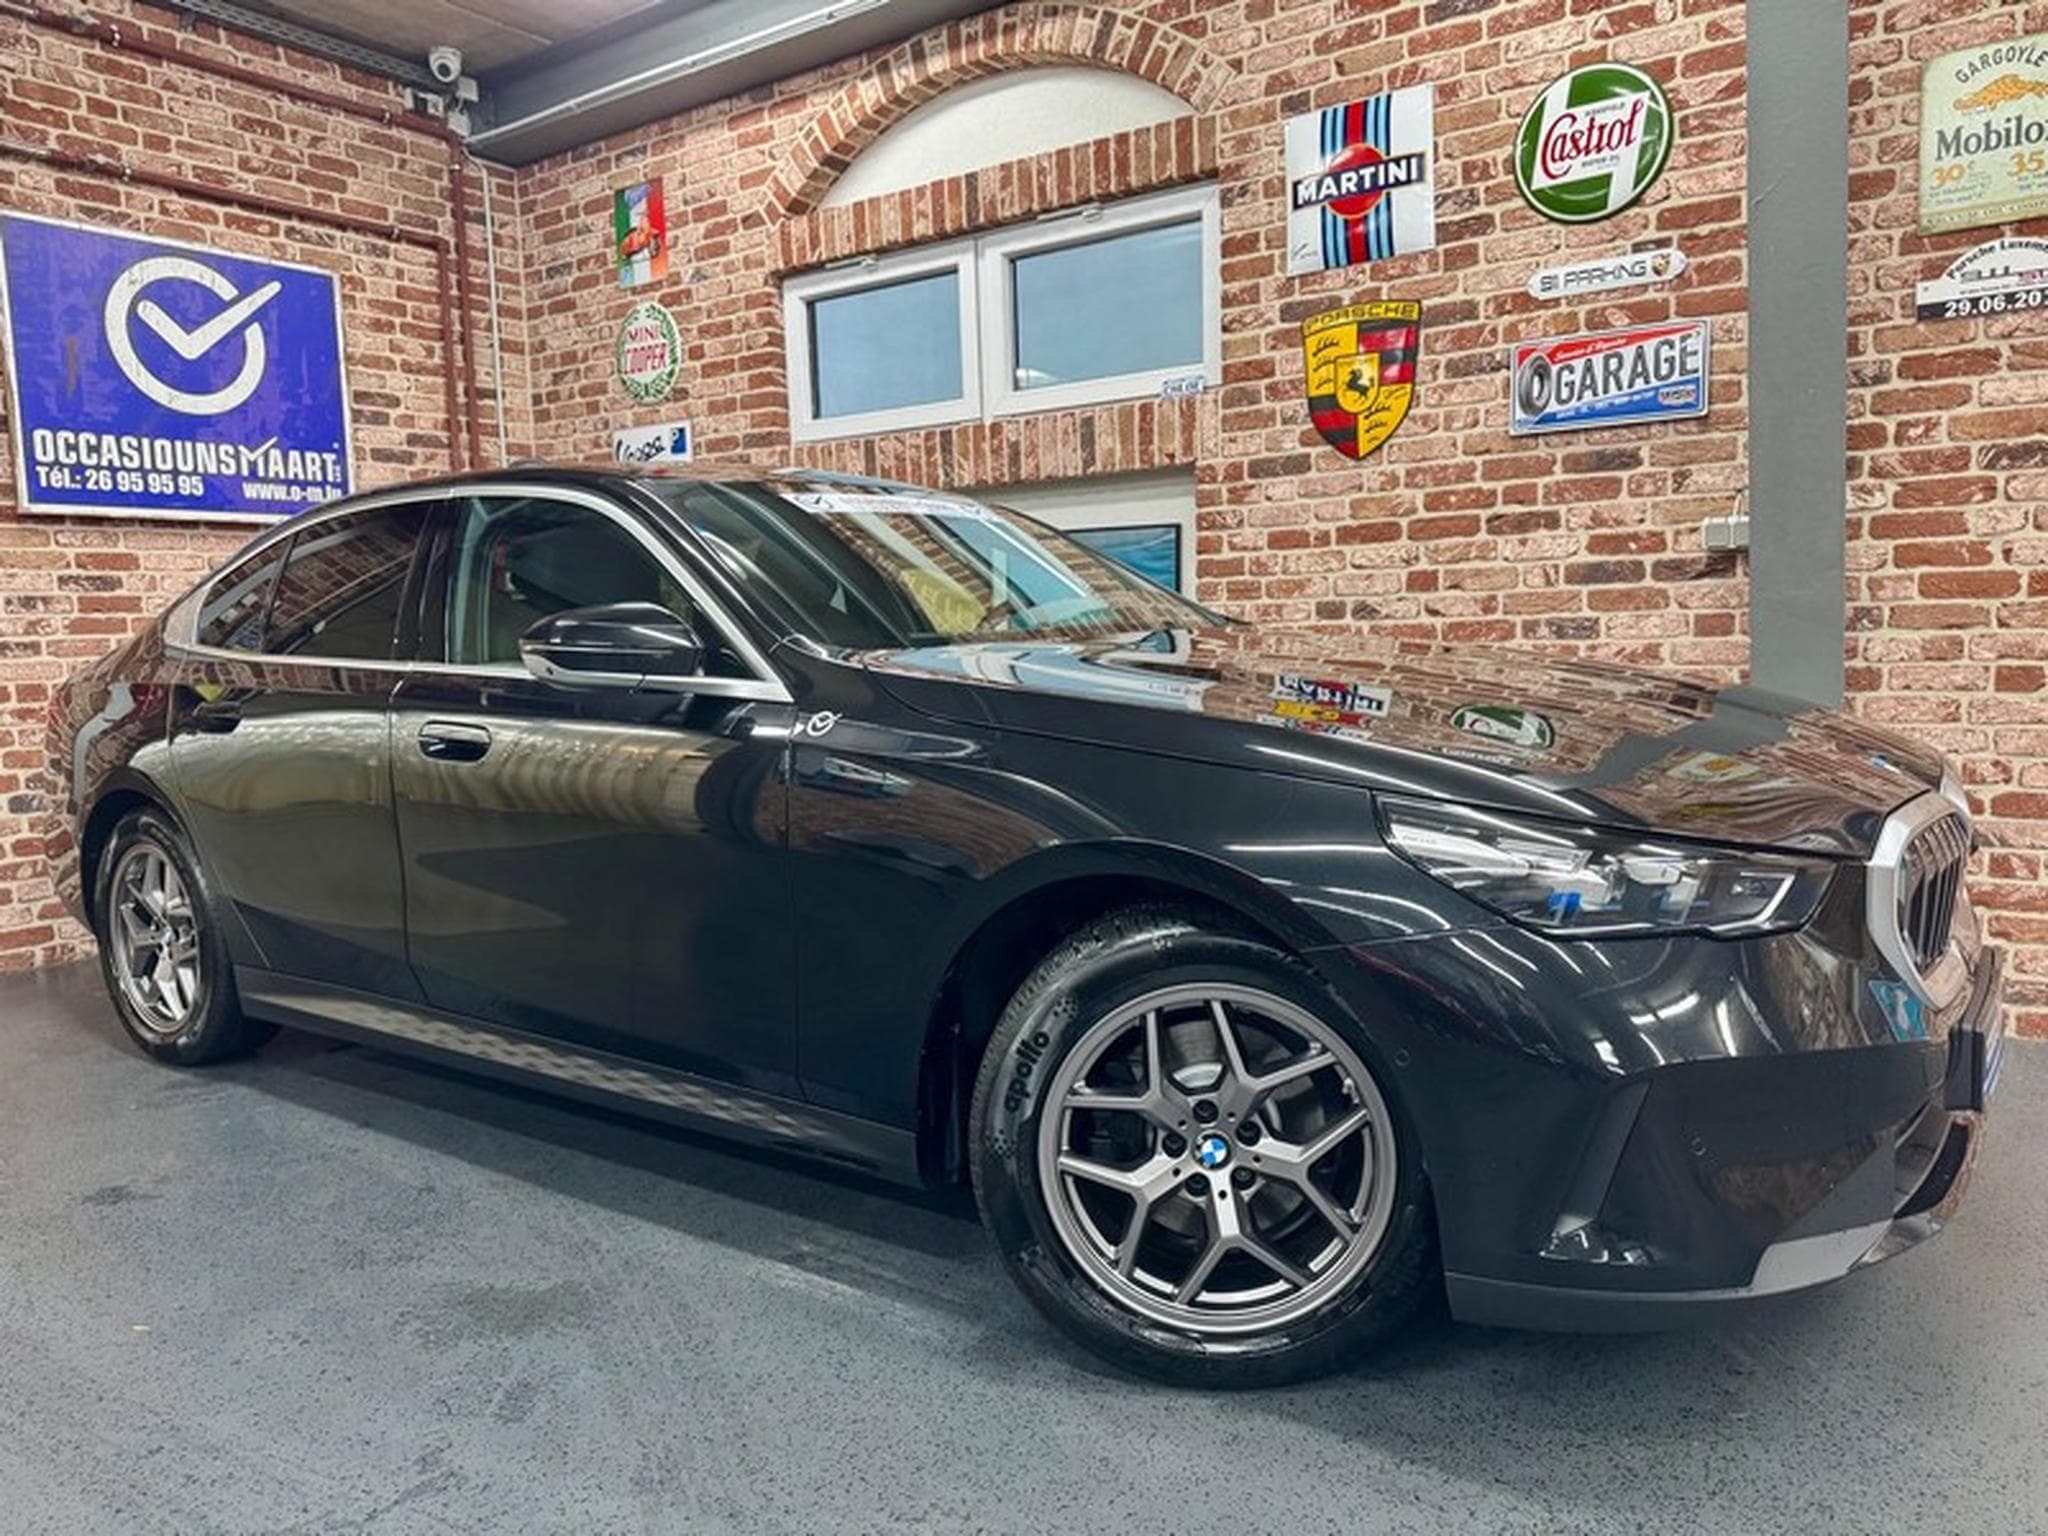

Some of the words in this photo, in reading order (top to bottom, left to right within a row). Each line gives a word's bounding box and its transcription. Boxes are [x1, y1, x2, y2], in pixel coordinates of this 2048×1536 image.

[1541, 98, 1644, 180] Castrol
[1935, 114, 2048, 162] Mobilo
[1297, 157, 1419, 206] MARTINI
[2001, 239, 2048, 254] Luxem
[1564, 260, 1647, 287] PARKING
[1307, 303, 1416, 331] PORSCHE
[1945, 291, 2048, 318] 29.06.20
[627, 326, 660, 342] MINI
[625, 343, 667, 374] COOPER
[1555, 333, 1700, 405] GARAGE
[85, 468, 110, 491] 26
[117, 471, 144, 493] 95
[148, 473, 175, 495] 95
[178, 475, 205, 497] 95
[1004, 1032, 1050, 1113] apollo
